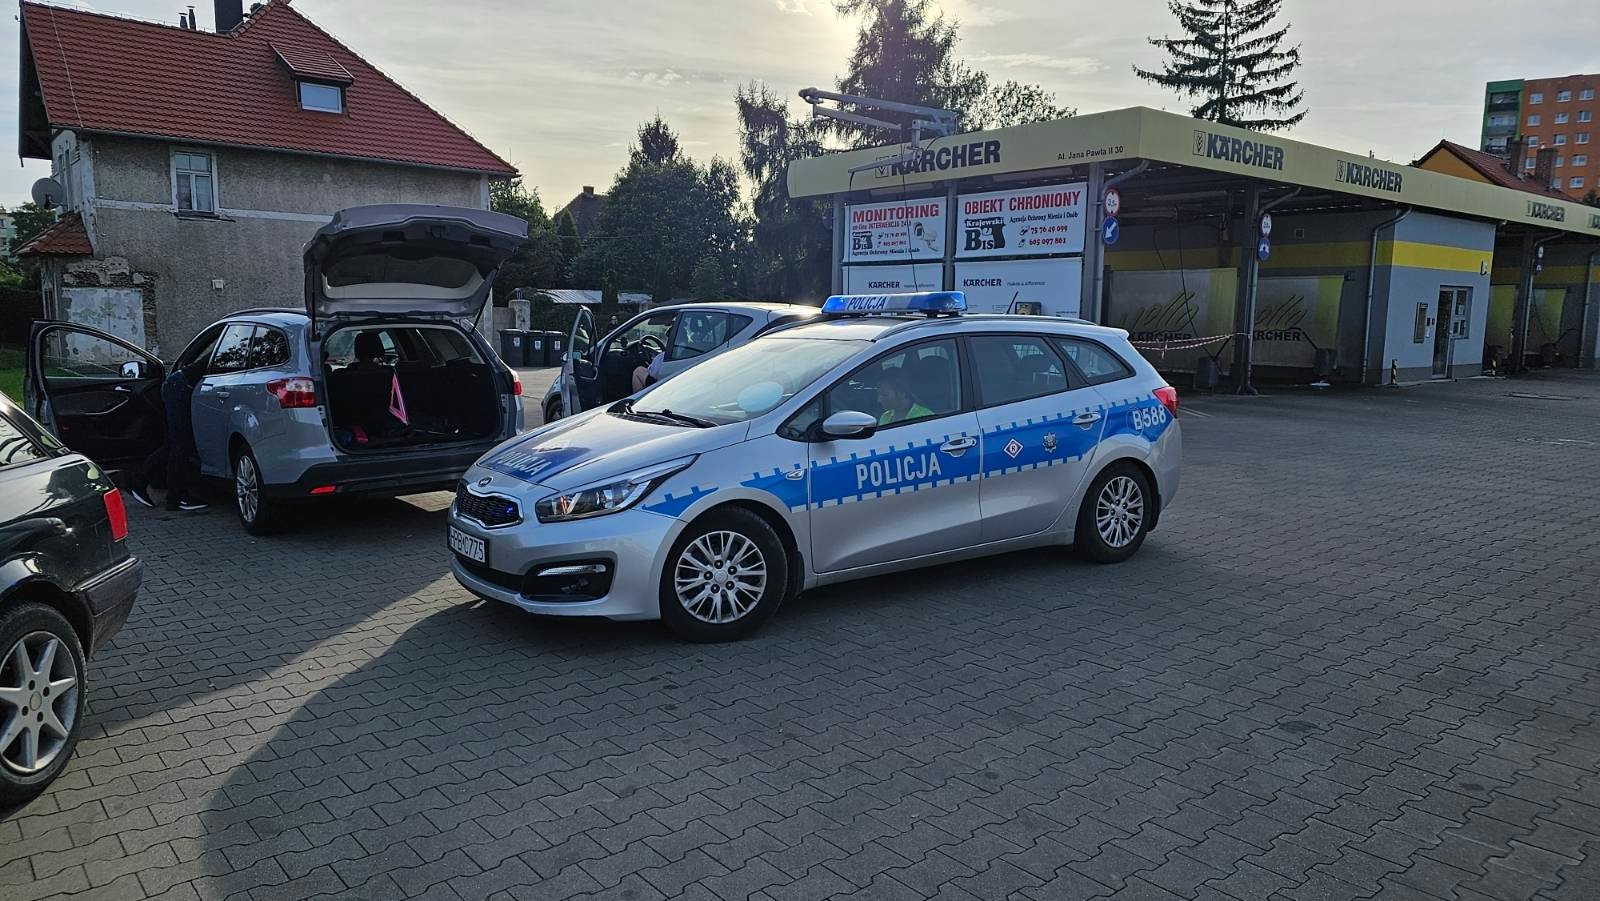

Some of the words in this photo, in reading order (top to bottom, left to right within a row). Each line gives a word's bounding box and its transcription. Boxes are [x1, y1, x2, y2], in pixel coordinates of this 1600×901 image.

[1108, 146, 1113, 154] II
[1114, 145, 1124, 153] 30
[1207, 133, 1284, 170] KÄRCHER
[1346, 162, 1402, 193] KÄRCHER
[853, 204, 939, 223] MONITORING
[964, 199, 1005, 215] OBIEKT
[1009, 191, 1081, 211] CHRONIONY
[847, 296, 888, 311] POLICJA
[1253, 331, 1301, 341] RCHER
[1132, 404, 1167, 431] B588
[496, 451, 553, 475] POLICJA
[856, 452, 942, 489] POLICJA
